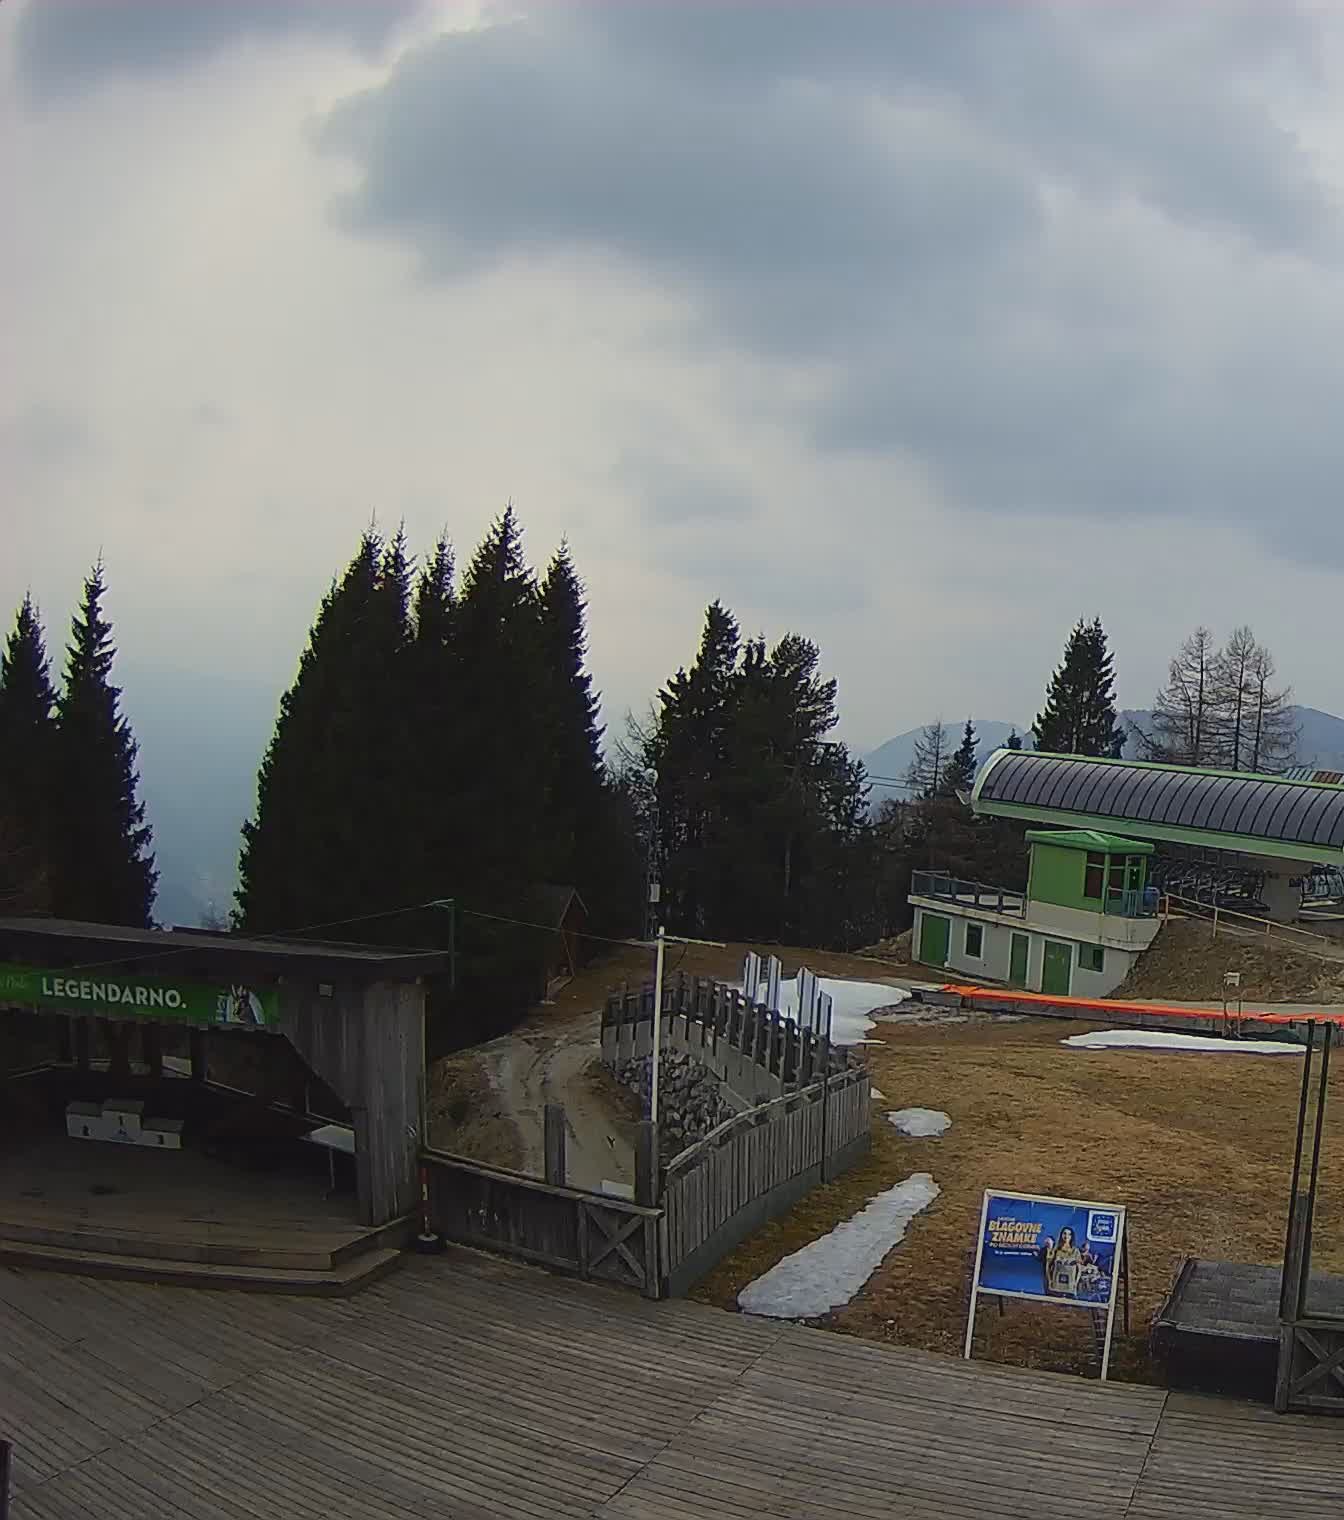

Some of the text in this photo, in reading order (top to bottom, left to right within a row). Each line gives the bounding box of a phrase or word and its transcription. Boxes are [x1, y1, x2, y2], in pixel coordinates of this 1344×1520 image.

[42, 977, 187, 1009] LEGENDARNO.
[988, 1220, 1043, 1233] BLAGOVNE
[992, 1232, 1037, 1244] ZNAMKE
